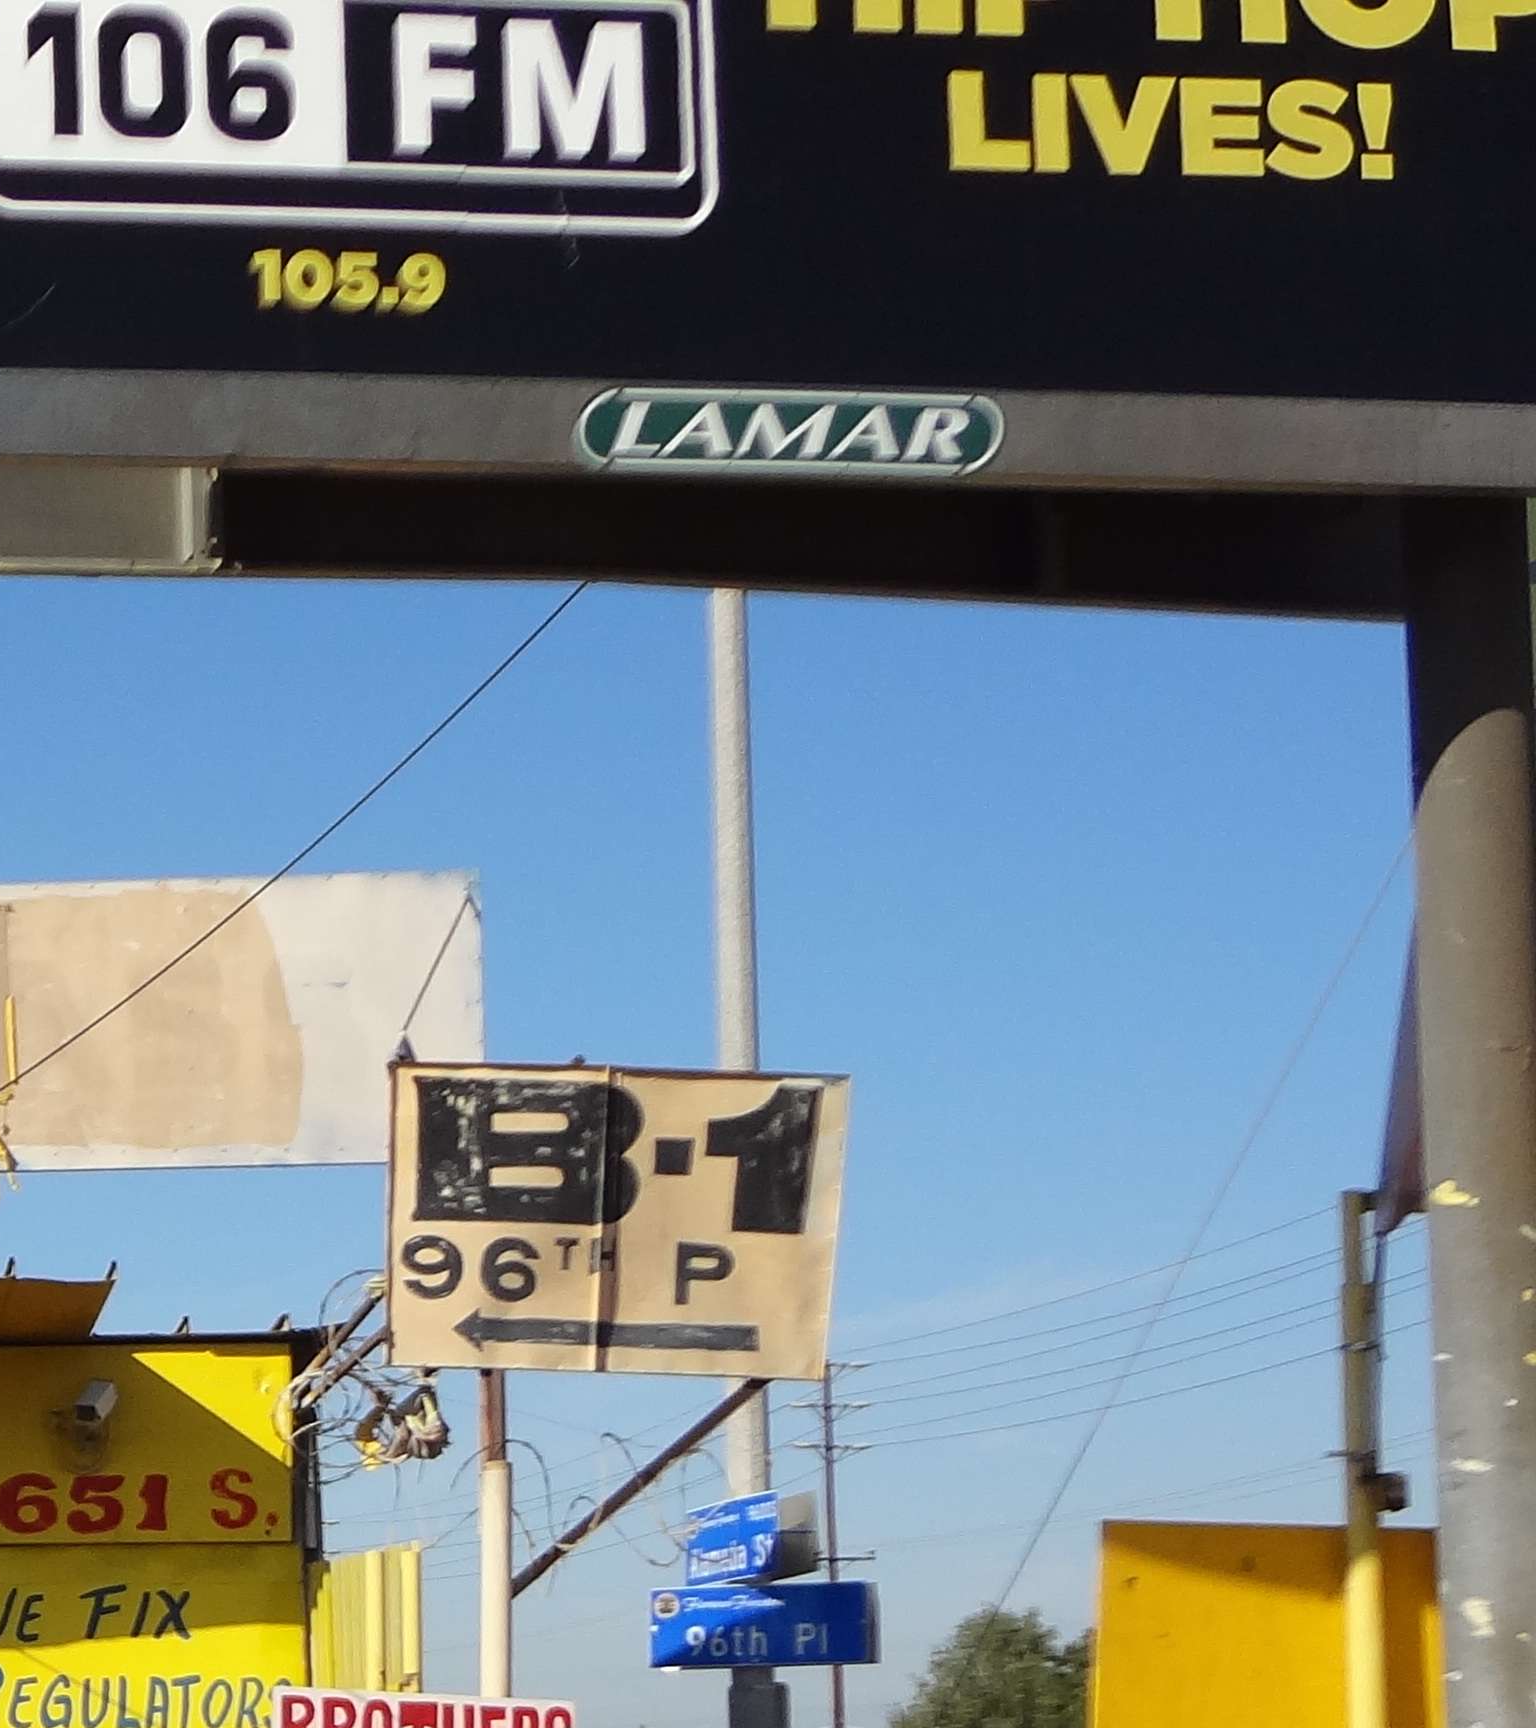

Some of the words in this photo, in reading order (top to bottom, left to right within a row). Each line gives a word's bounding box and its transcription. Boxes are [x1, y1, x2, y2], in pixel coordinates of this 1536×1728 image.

[26, 0, 299, 142] 106
[392, 13, 646, 162] FM
[947, 69, 1395, 180] LIVES!
[252, 248, 448, 314] 105.9
[608, 400, 970, 463] LAMAR
[674, 1241, 735, 1305] P
[79, 1583, 191, 1640] FIX
[685, 1623, 768, 1658] 96th
